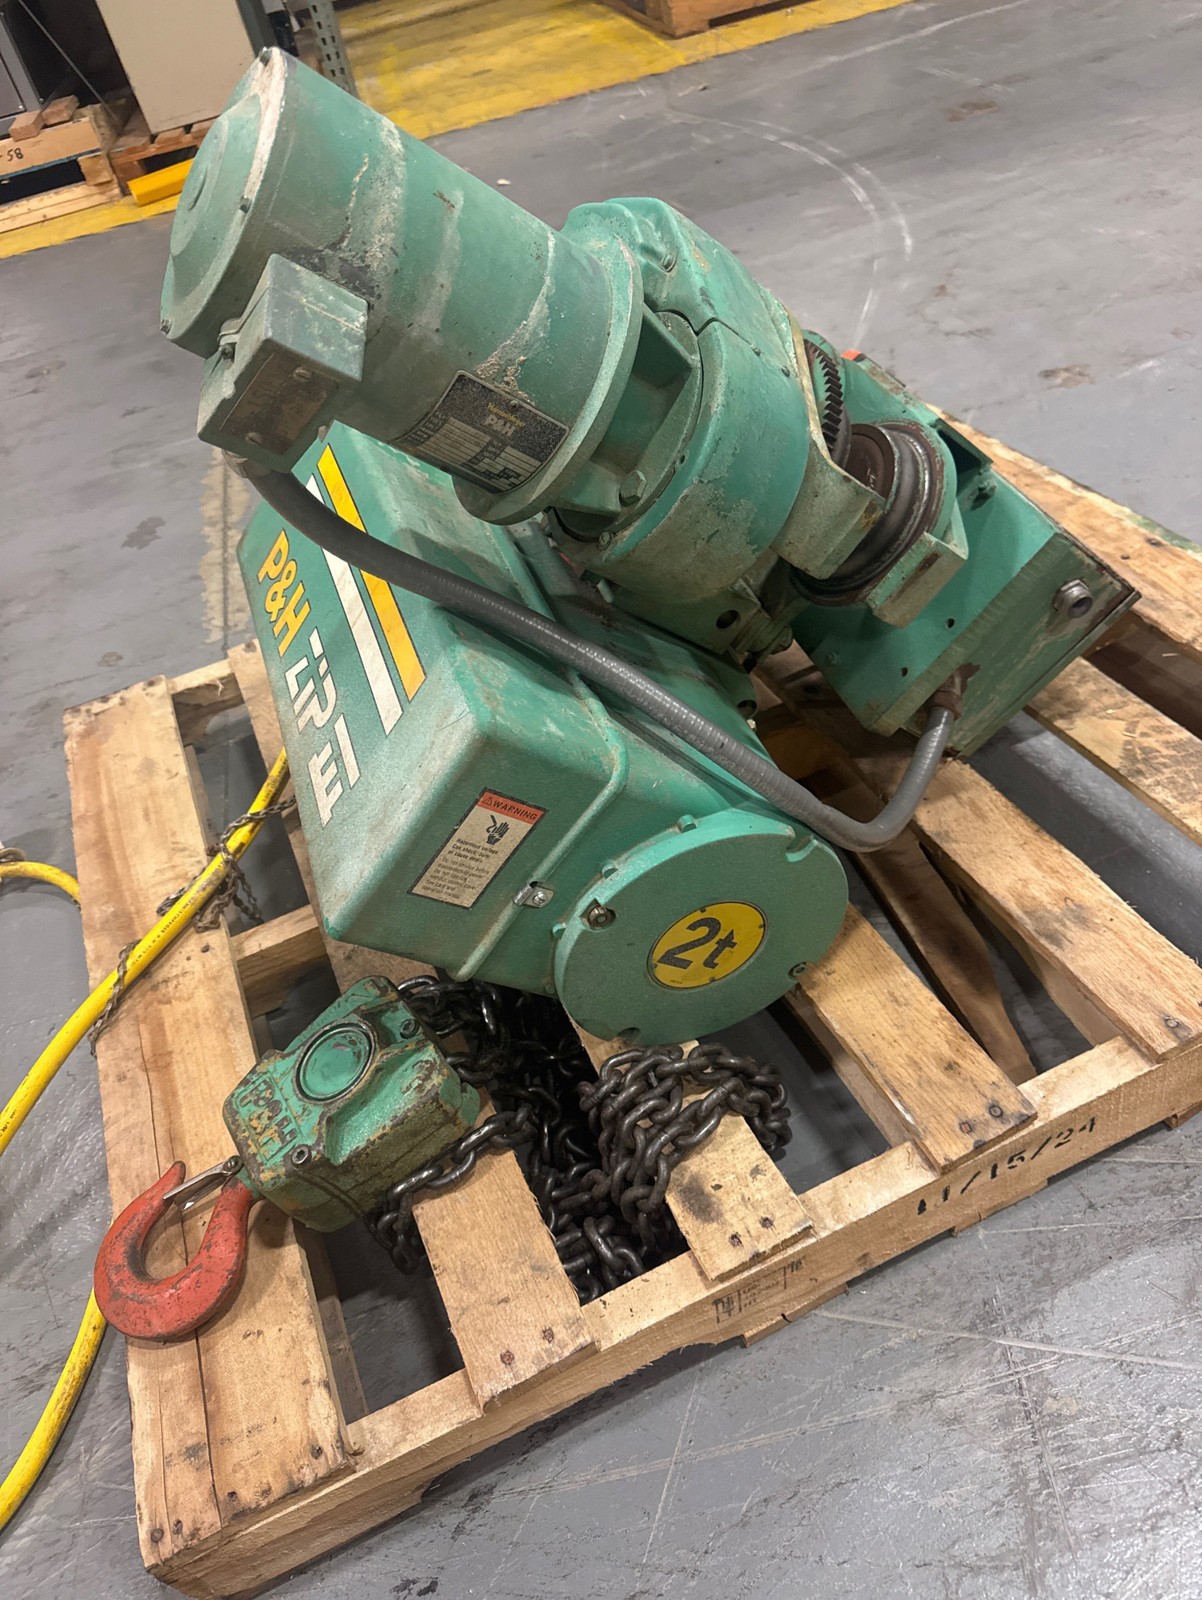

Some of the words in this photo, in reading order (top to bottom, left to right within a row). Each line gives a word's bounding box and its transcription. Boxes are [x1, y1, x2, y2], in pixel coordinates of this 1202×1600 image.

[483, 414, 516, 437] P&H
[258, 528, 312, 657] P&H
[493, 799, 538, 820] WARNING
[657, 917, 737, 970] 2t
[239, 1079, 298, 1148] P&H
